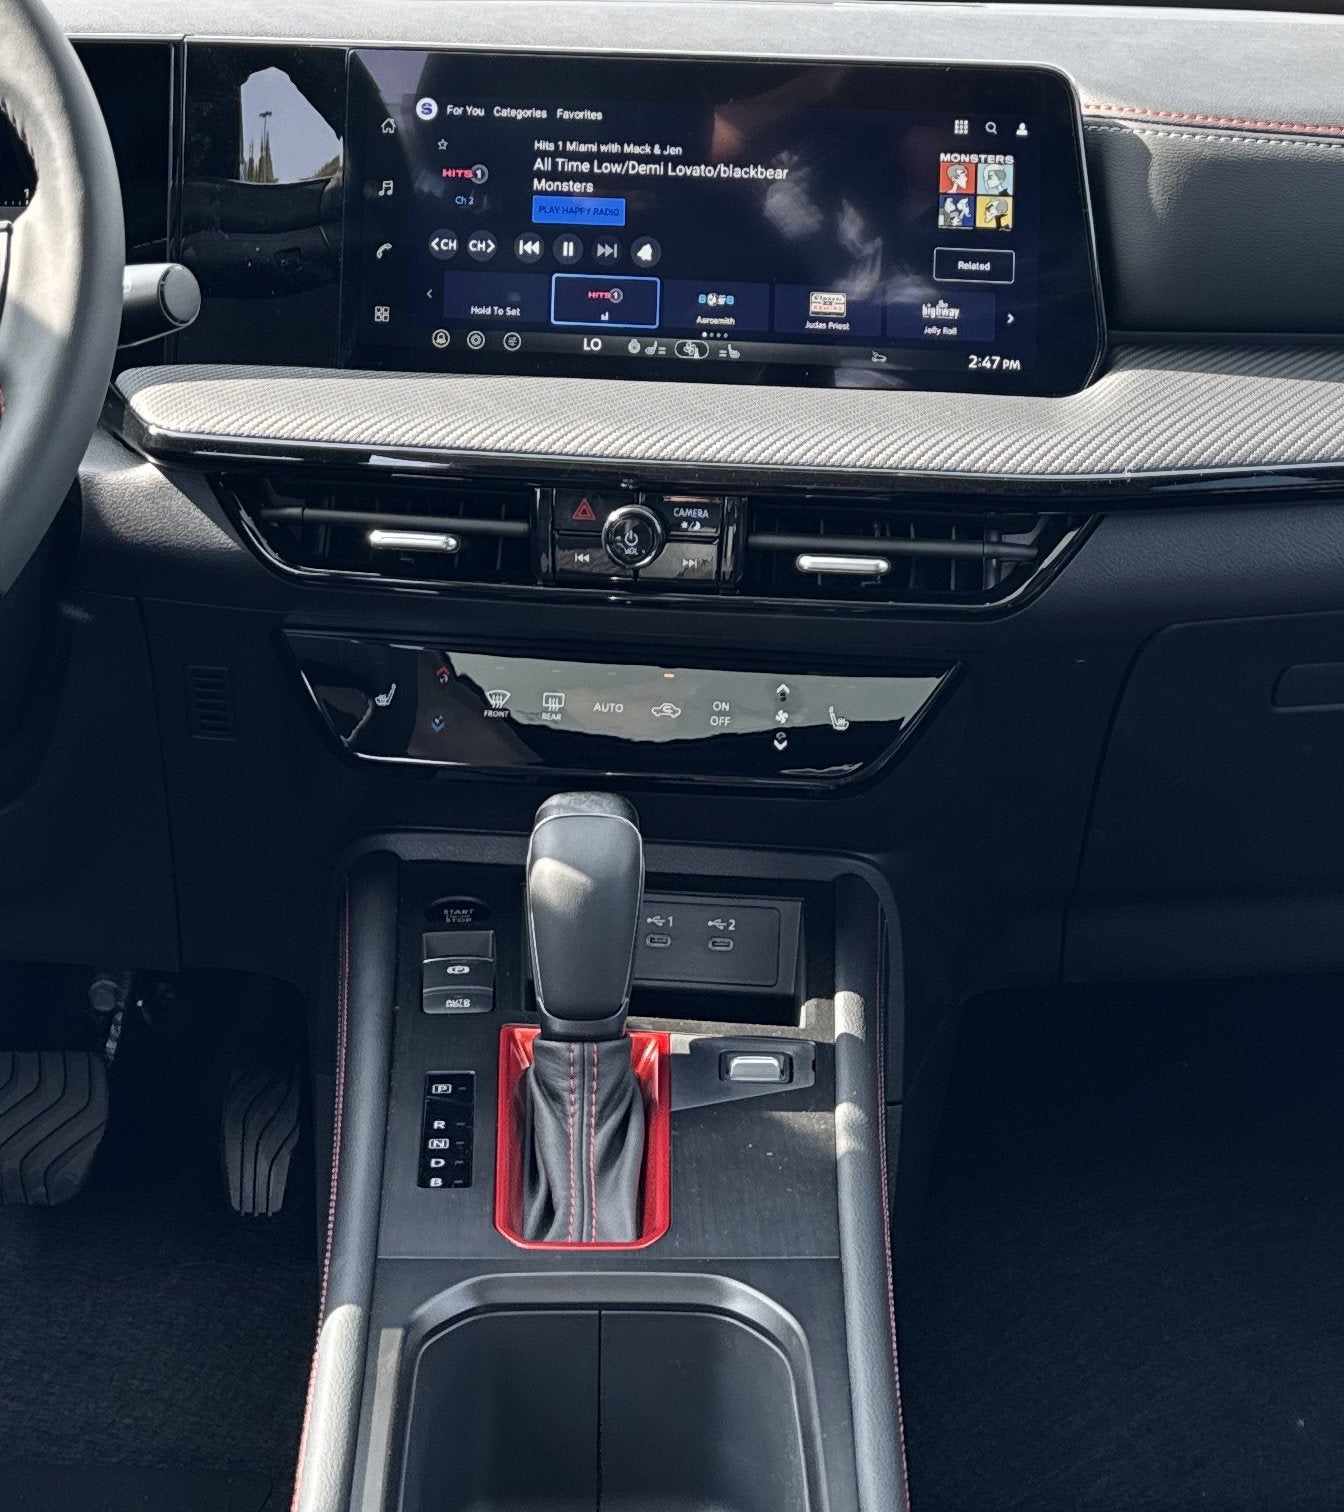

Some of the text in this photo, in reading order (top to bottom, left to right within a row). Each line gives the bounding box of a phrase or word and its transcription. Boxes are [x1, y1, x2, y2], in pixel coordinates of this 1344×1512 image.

[446, 104, 485, 117] For You
[493, 106, 548, 120] Categories
[556, 108, 603, 120] Favorites
[534, 140, 555, 151] Hits
[566, 141, 598, 152] Miami
[600, 142, 622, 154] with
[624, 143, 652, 155] Mack
[653, 144, 662, 155] &
[663, 144, 683, 157] Jen
[939, 152, 1015, 165] MONSTERS
[441, 168, 473, 179] HITS
[533, 157, 789, 181] All Time Low/Demi Lovato/blackbear
[532, 178, 594, 194] Monsters
[23, 188, 30, 197] 1
[455, 195, 468, 206] Ch
[538, 205, 621, 217] PLAY HAPPY RADIO
[957, 260, 991, 272] Related
[470, 305, 521, 317] Hold To Set
[696, 315, 736, 326] Aerosmith
[805, 320, 850, 331] Judas Priest
[583, 338, 602, 352] LO
[967, 355, 1021, 371] 2:47 PM
[673, 507, 709, 519] CAMERA
[593, 702, 624, 713] AUTO
[712, 701, 731, 712] ON
[483, 709, 510, 718] FRONT
[541, 712, 562, 721] REAR
[709, 716, 731, 727] OFF
[667, 916, 673, 927] 1
[728, 919, 736, 930] 2
[433, 1120, 446, 1130] R
[430, 1158, 446, 1168] D
[430, 1177, 443, 1187] B
